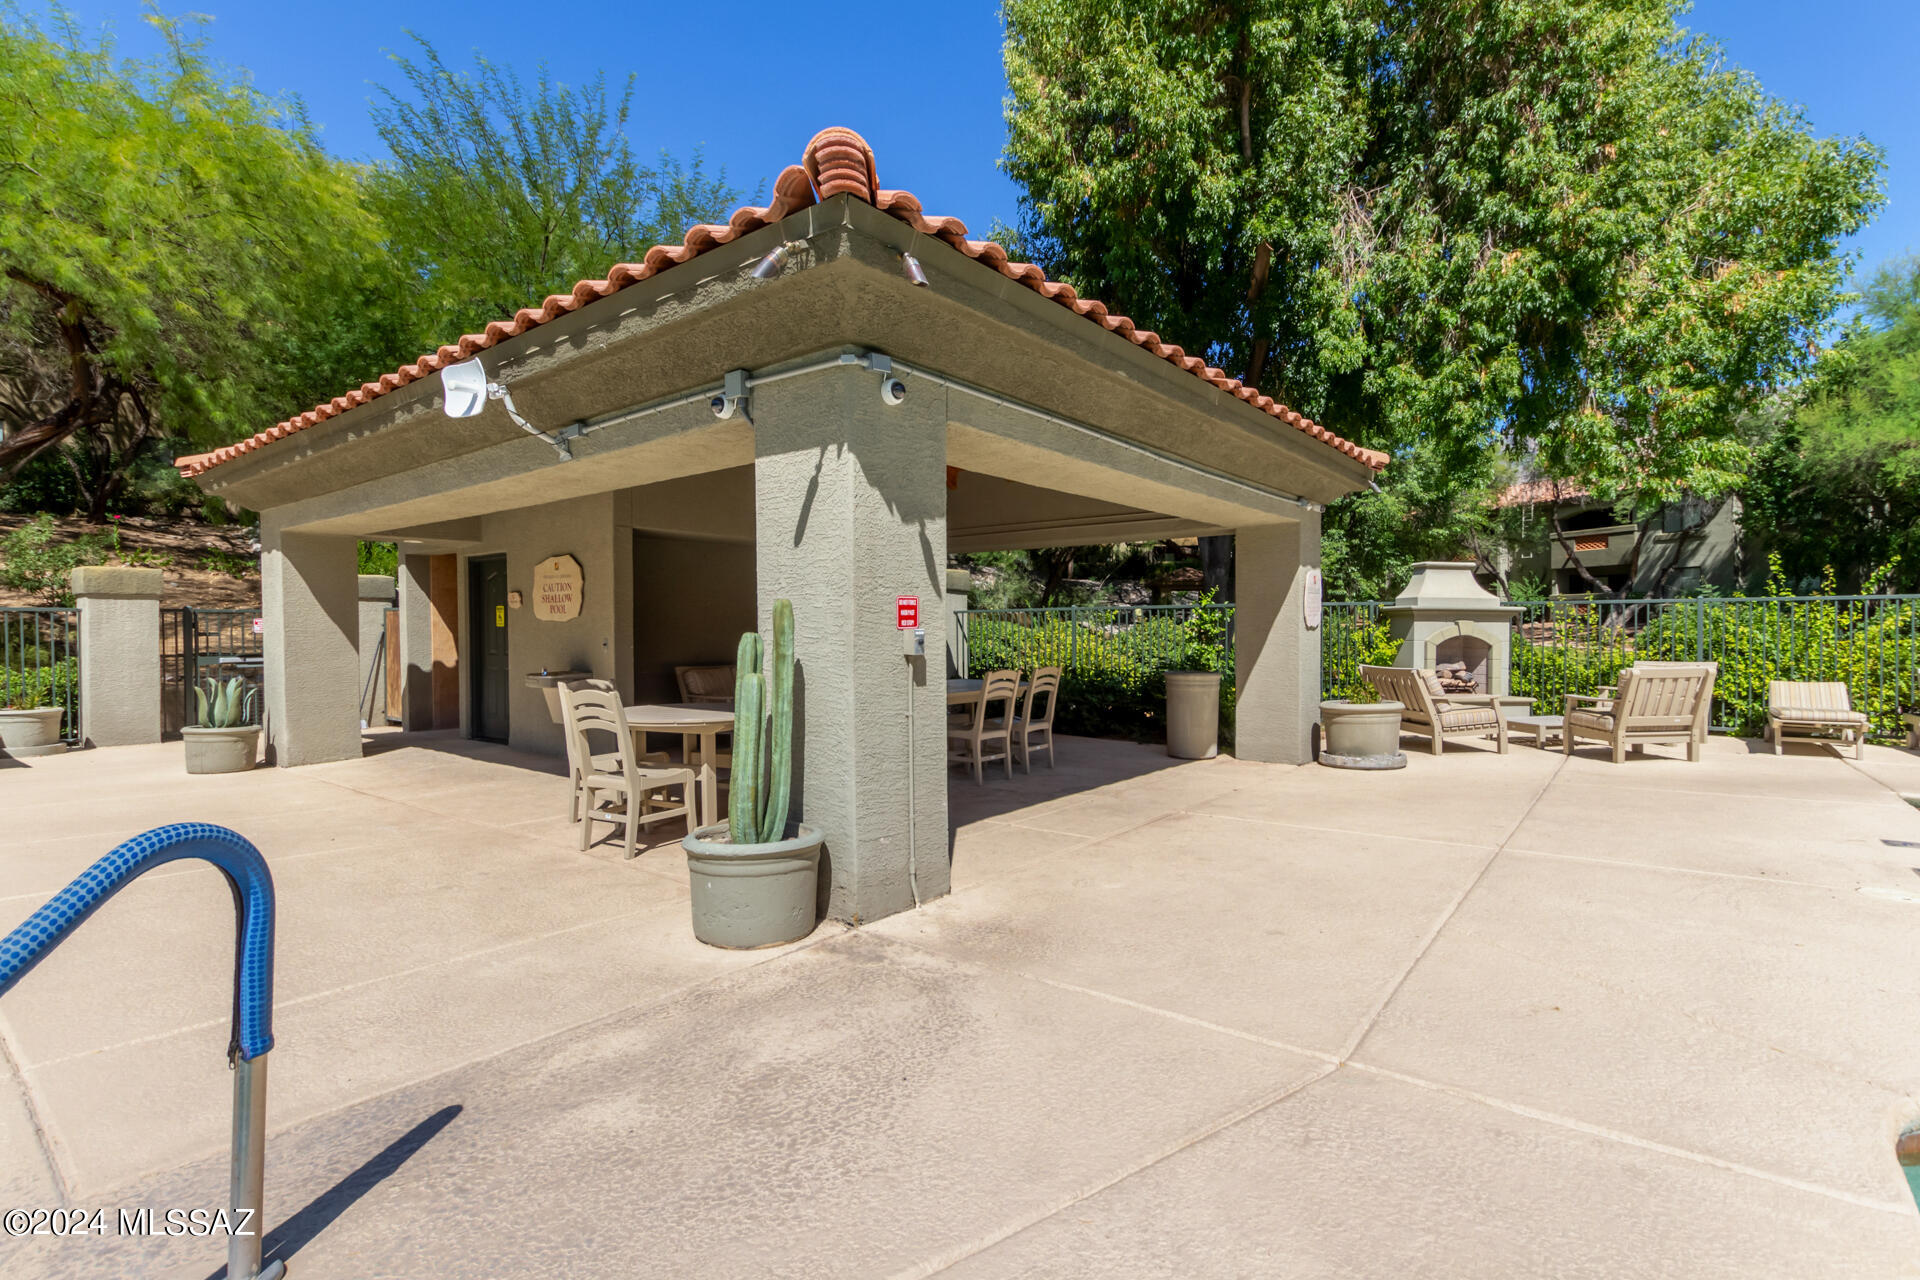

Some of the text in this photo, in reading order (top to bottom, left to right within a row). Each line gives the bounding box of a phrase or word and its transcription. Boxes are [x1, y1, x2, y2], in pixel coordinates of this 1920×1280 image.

[542, 582, 572, 593] CAUTION
[542, 593, 573, 604] SHALLOW
[550, 604, 567, 614] POOL
